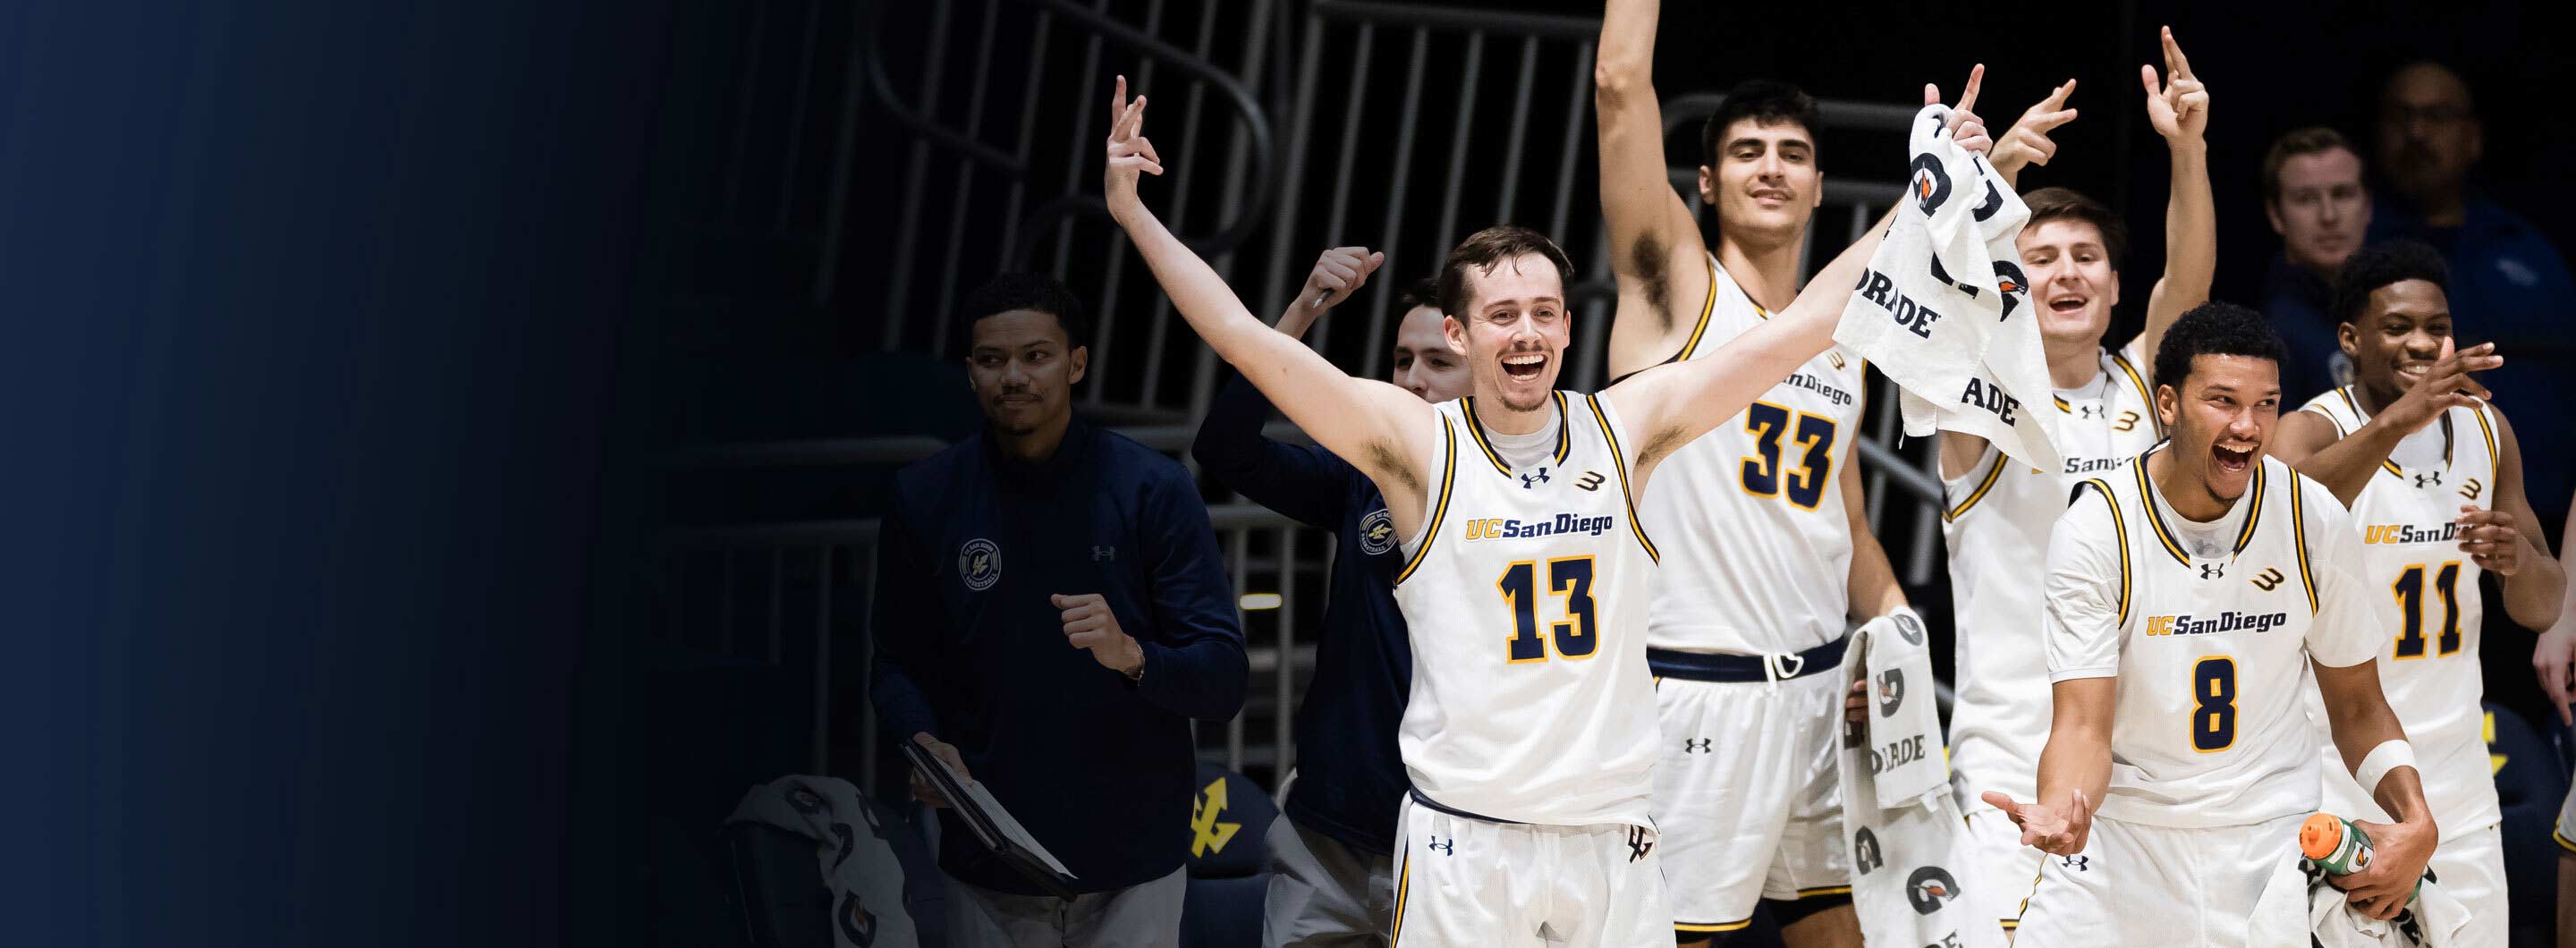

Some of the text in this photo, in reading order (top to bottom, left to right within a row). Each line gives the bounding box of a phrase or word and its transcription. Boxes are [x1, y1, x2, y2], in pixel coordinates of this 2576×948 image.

[1740, 400, 1838, 512] 33
[1496, 554, 1601, 664] 13
[2391, 560, 2462, 660] 11
[2190, 655, 2240, 754] 8
